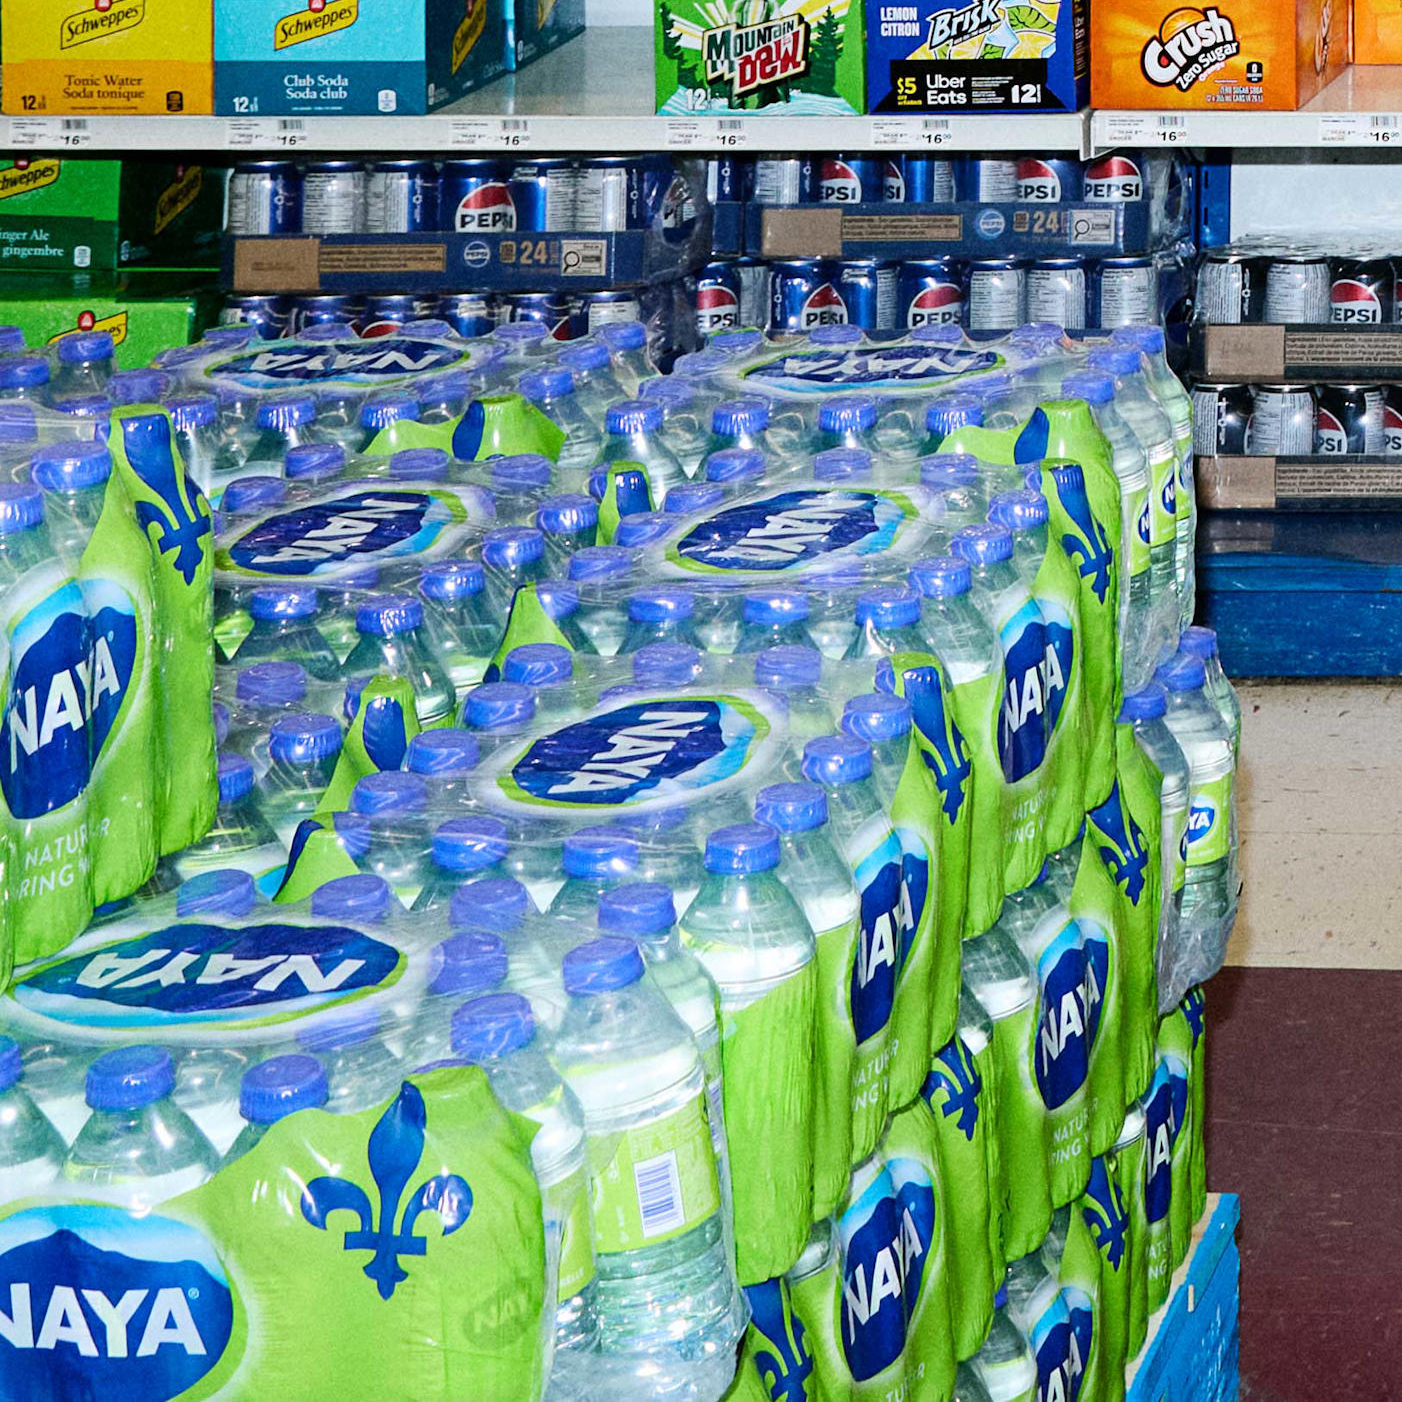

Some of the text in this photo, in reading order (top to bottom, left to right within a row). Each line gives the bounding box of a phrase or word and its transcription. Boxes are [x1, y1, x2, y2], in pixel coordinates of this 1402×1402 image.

[66, 5, 141, 41] Schweppes
[280, 5, 355, 40] Schweppes
[1144, 9, 1234, 83] Crush
[926, 74, 966, 89] Uber
[1176, 42, 1238, 89] Zero Sugar
[927, 90, 967, 105] Eats
[9, 635, 121, 769] NAYA
